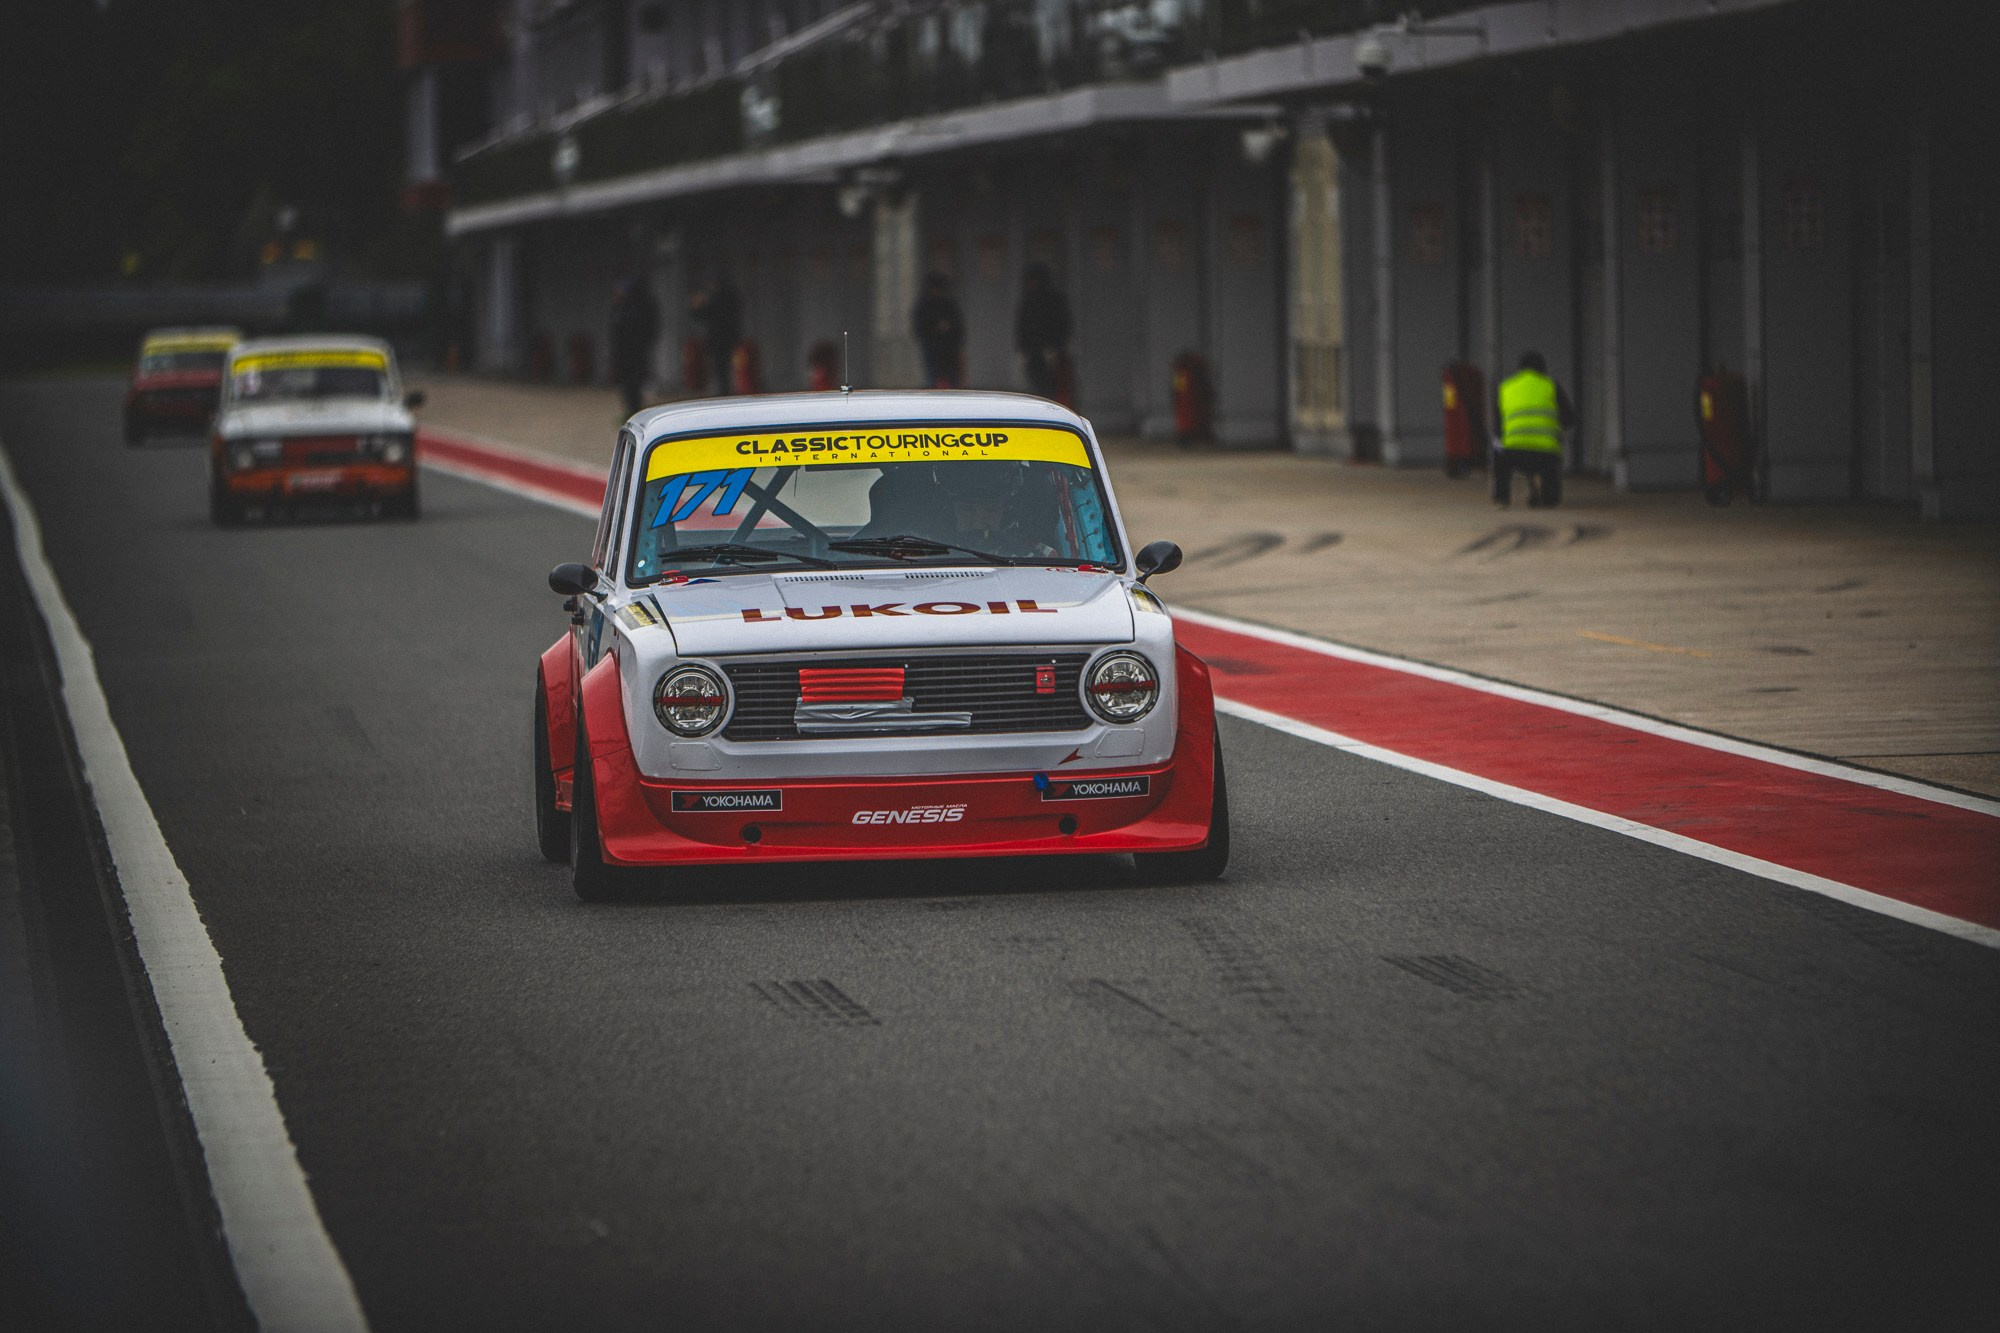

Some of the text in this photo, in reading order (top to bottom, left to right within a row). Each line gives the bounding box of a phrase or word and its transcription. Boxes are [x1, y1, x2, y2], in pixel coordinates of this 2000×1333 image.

[759, 450, 988, 463] INTERNATIONAL
[651, 467, 756, 529] 171
[741, 599, 1059, 622] LUKOIL
[1072, 781, 1142, 795] YOKOHAMA
[702, 795, 774, 807] YOKOHAMA
[851, 808, 966, 825] GENESIS
